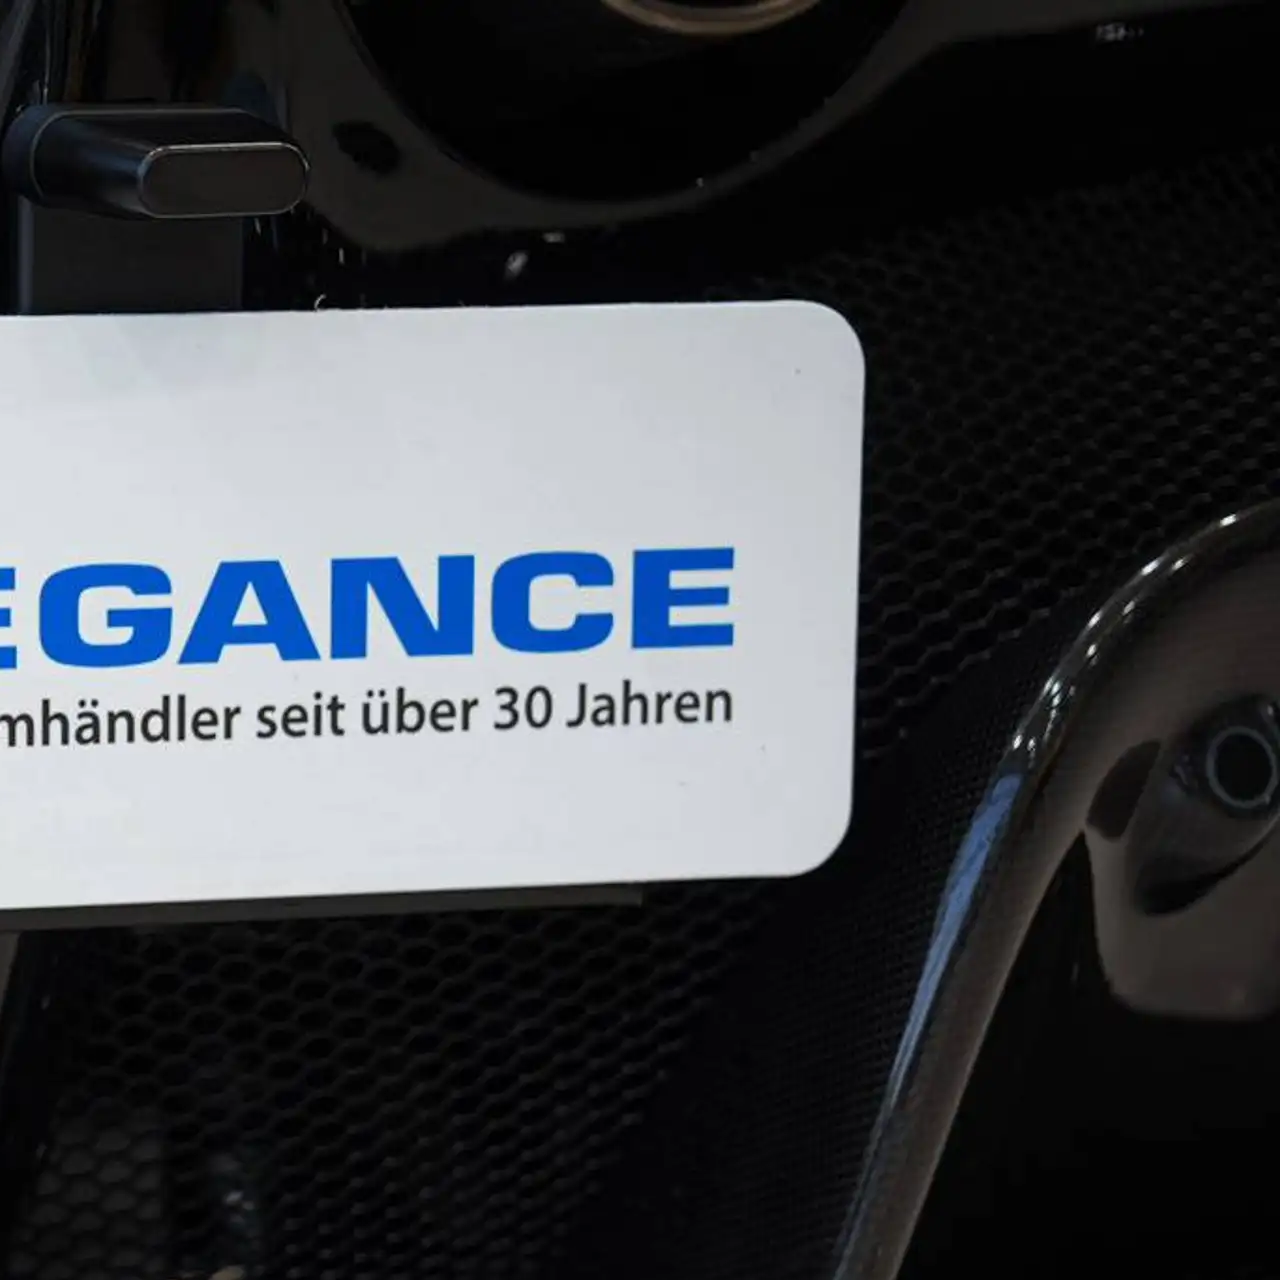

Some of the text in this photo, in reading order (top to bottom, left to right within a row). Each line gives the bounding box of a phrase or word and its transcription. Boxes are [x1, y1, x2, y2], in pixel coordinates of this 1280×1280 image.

[255, 691, 345, 739] seit
[361, 686, 479, 735] über
[493, 685, 553, 730] 30
[565, 679, 732, 728] Jahren
